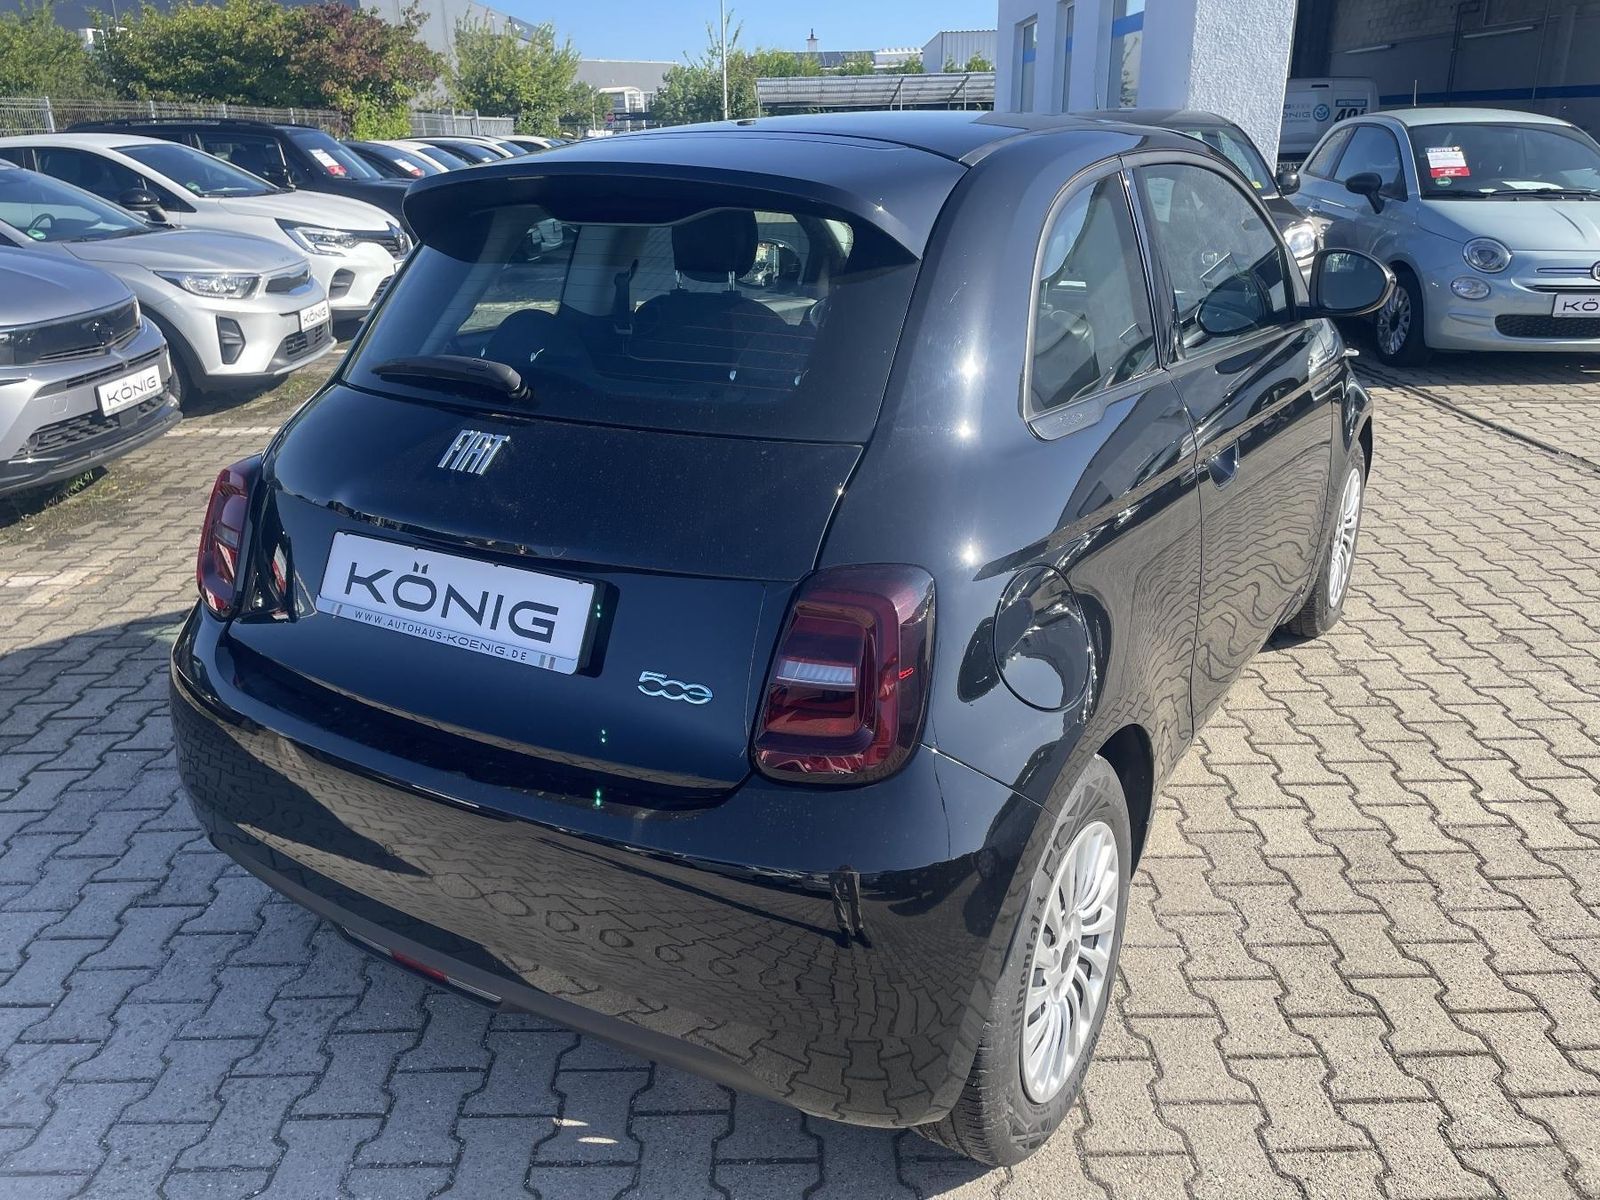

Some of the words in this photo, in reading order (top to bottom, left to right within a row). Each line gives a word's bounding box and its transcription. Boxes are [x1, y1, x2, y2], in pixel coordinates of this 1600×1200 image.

[303, 306, 327, 323] KÖNIG
[1563, 298, 1599, 311] KÖ
[106, 376, 158, 406] KÖNIG
[437, 429, 511, 475] FIAT
[344, 561, 559, 643] KÖNIG
[354, 610, 527, 661] WWW.AUTOHAUS-KOENIG.DE
